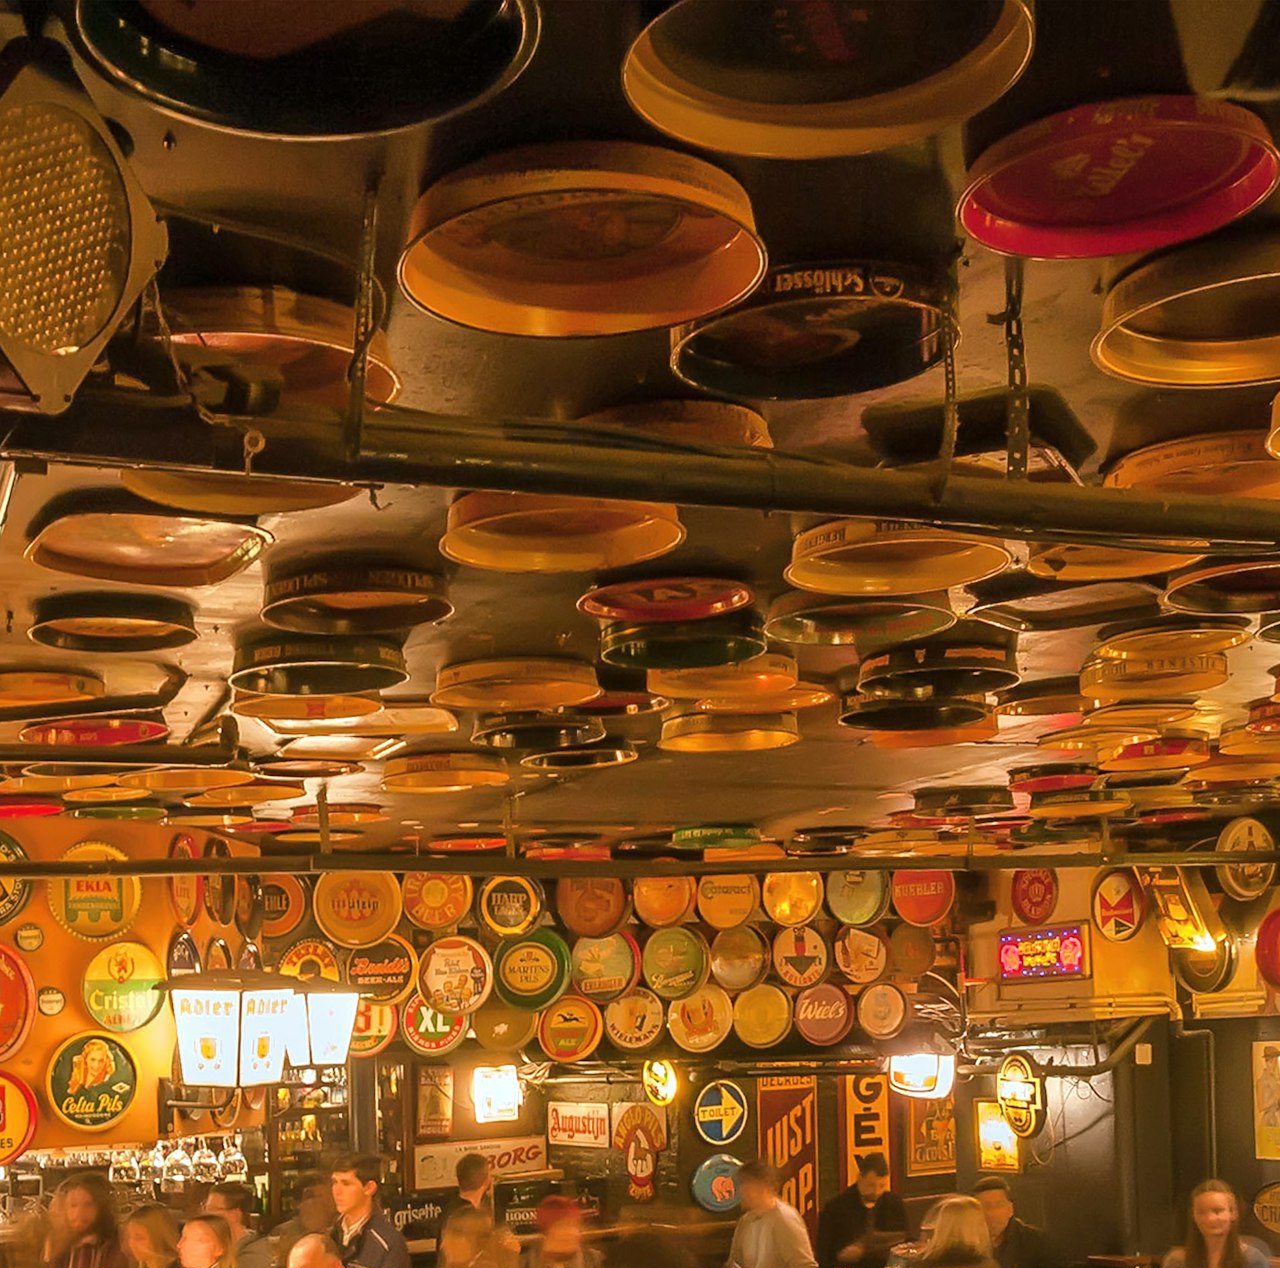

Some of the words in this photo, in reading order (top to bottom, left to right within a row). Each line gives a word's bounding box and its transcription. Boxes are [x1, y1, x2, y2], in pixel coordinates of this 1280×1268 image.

[774, 269, 865, 293] Schlösser
[86, 880, 122, 893] EKLA
[508, 965, 550, 975] MARTENS
[418, 1005, 451, 1033] XL
[798, 998, 847, 1021] Wiel's
[61, 1096, 96, 1114] Celta
[96, 1093, 124, 1112] Pils
[701, 1106, 736, 1120] TOILET
[549, 1107, 606, 1141] Augustijn
[394, 1203, 442, 1232] grisette
